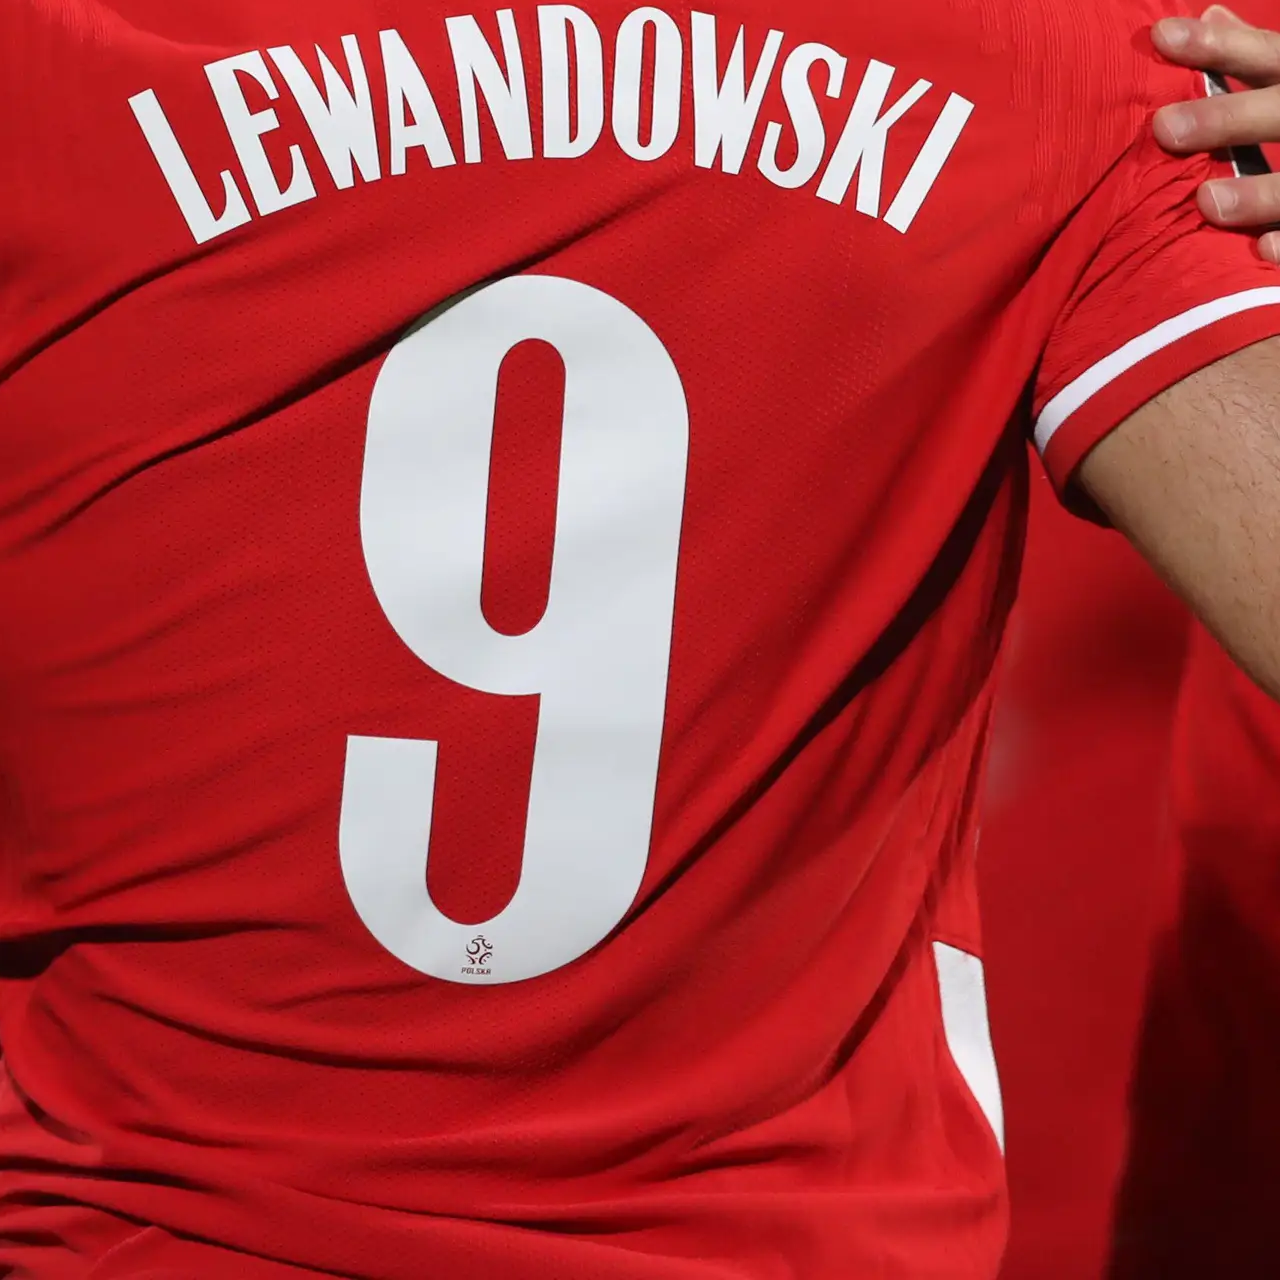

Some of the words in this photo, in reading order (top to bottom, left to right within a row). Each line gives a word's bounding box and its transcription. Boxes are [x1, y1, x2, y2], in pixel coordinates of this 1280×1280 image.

[127, 4, 975, 245] LEWANDOWSKI
[338, 274, 690, 985] 9
[461, 967, 491, 975] POLSKA
